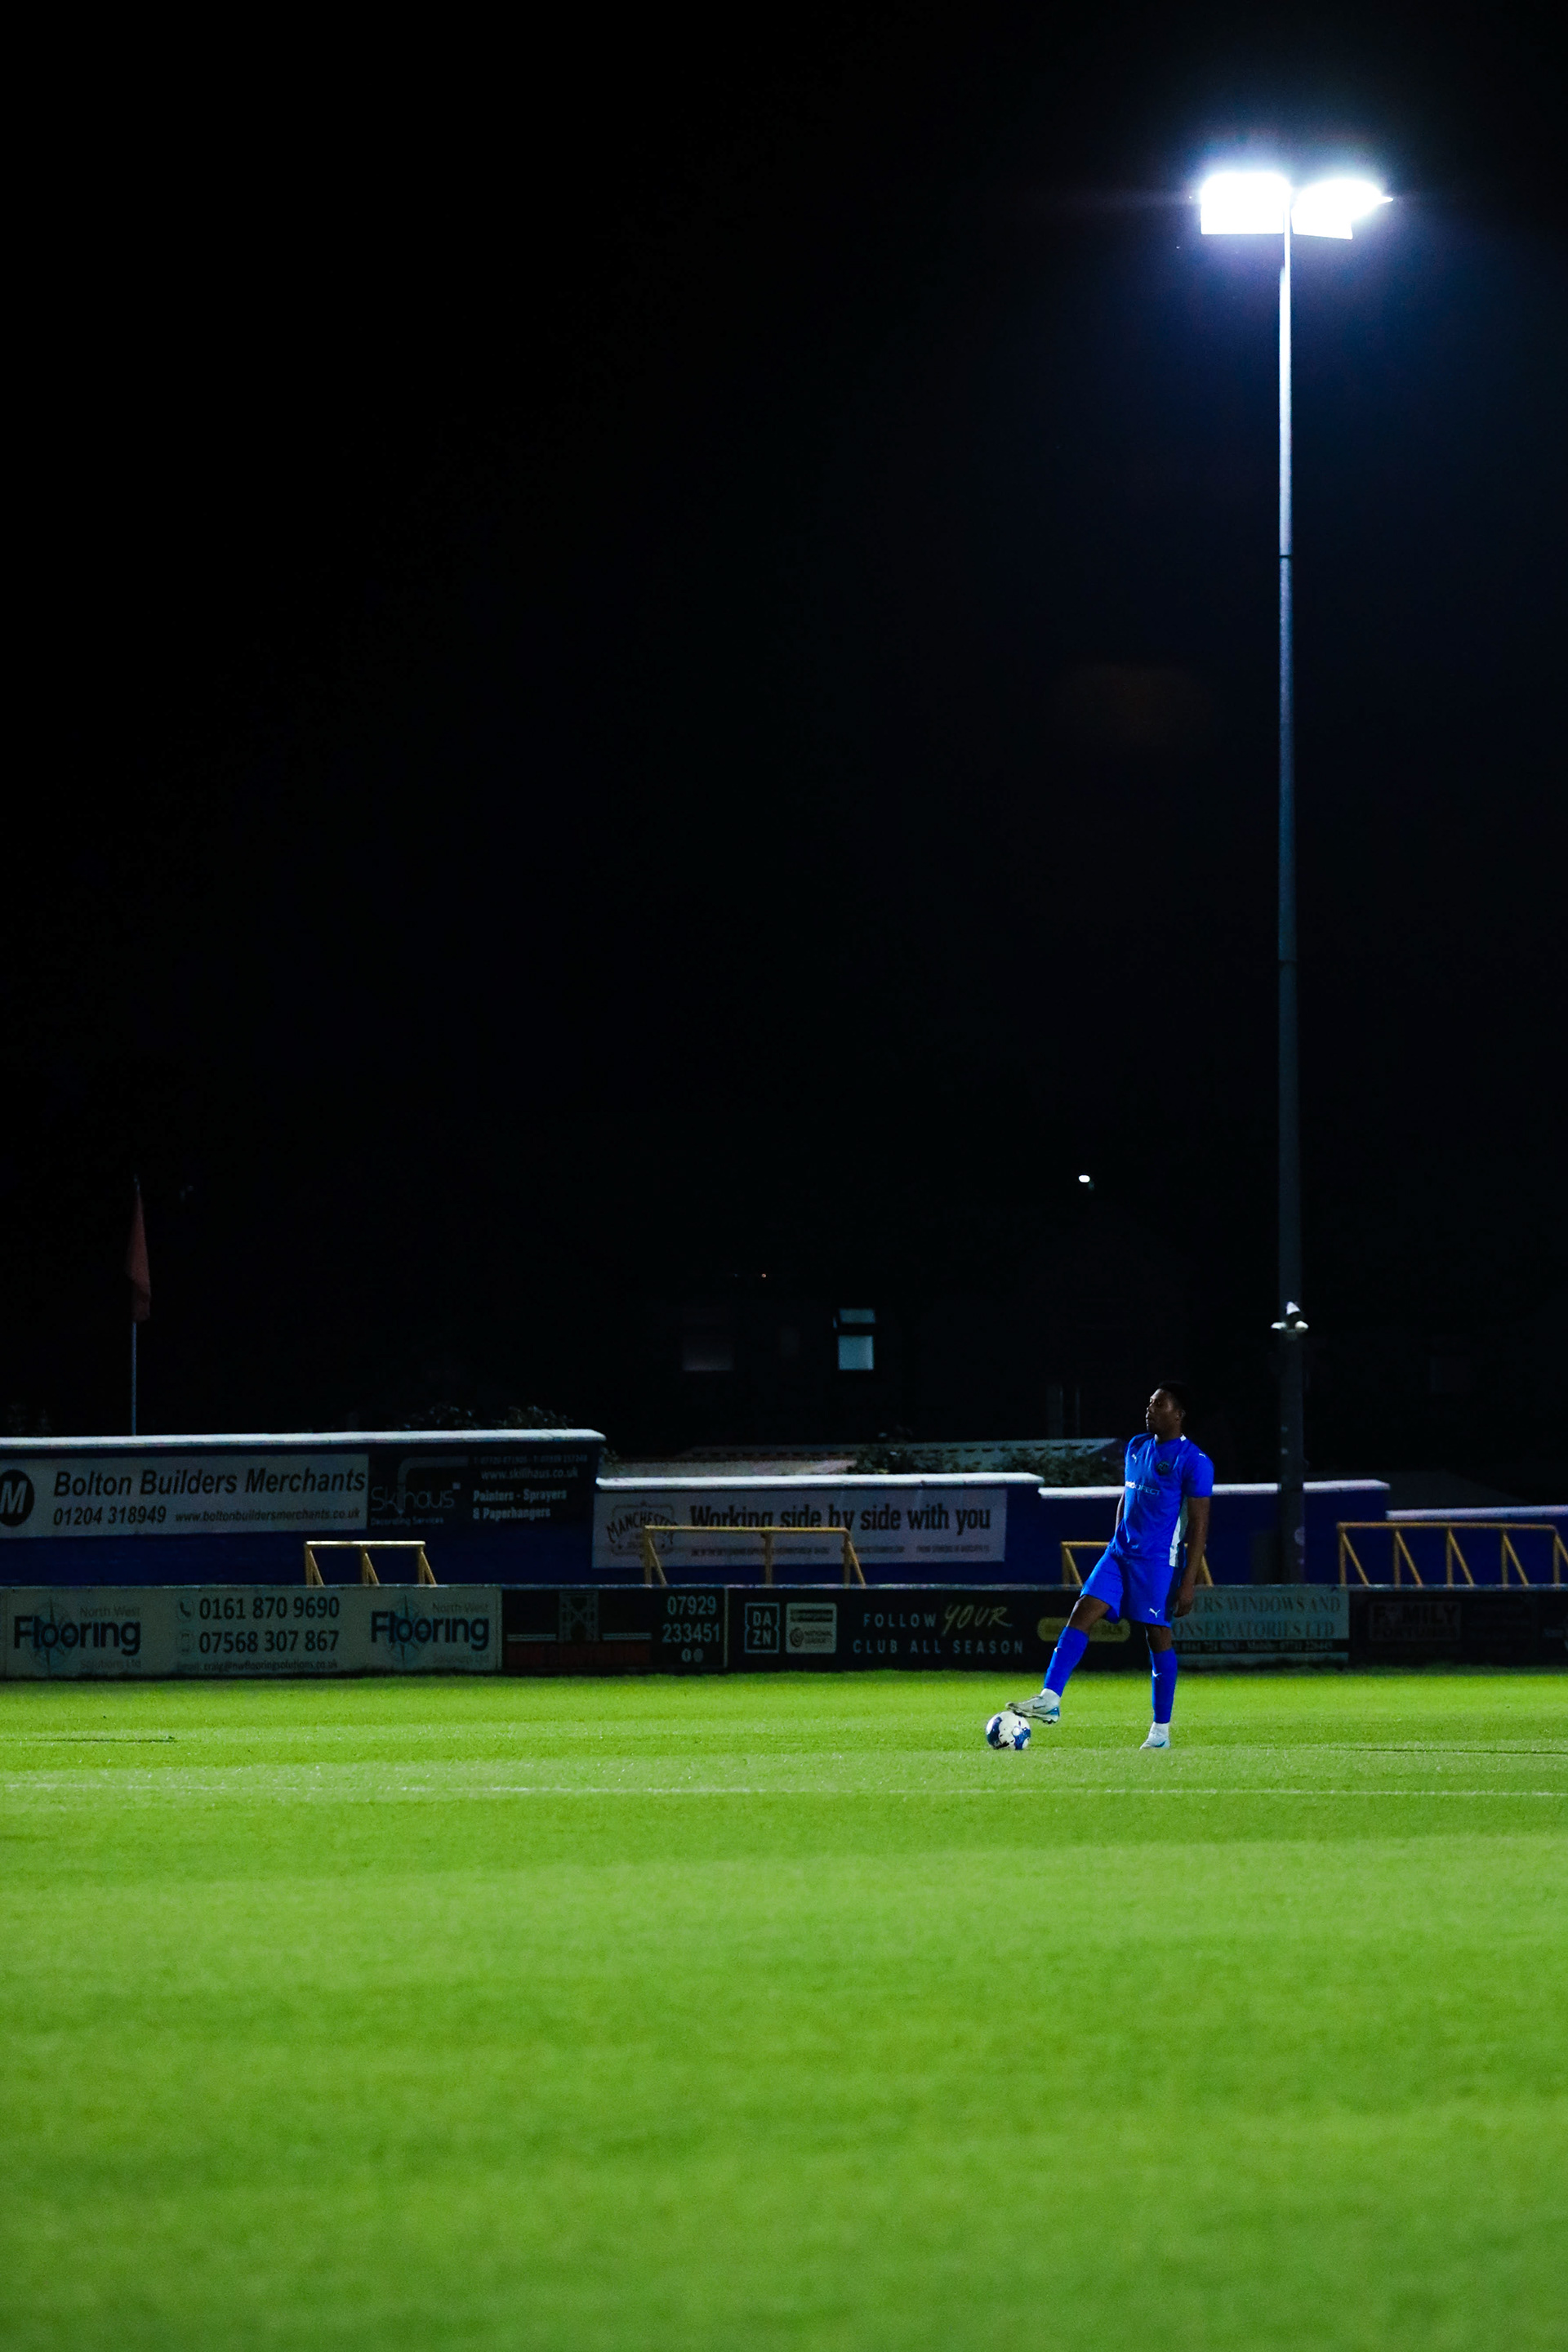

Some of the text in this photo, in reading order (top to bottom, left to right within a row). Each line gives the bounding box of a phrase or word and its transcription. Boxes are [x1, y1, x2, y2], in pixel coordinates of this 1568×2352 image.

[54, 1467, 366, 1496] Bolton Builders Merchants
[473, 1490, 514, 1502] Painters
[523, 1488, 568, 1503] Sprayers
[53, 1505, 167, 1526] 01204 318949
[473, 1507, 551, 1521] & Paperhangers
[781, 1504, 822, 1527] side
[829, 1504, 855, 1530] by
[860, 1503, 902, 1530] side
[907, 1503, 949, 1530] with
[956, 1508, 991, 1535] you
[199, 1597, 340, 1619] 0161 870 9690
[667, 1595, 717, 1615] 07929
[1227, 1597, 1305, 1613] WINDOWS
[1310, 1596, 1341, 1612] AND
[752, 1610, 773, 1627] DA
[863, 1604, 1013, 1637] FOLLOW YOUR
[14, 1615, 140, 1656] Flooring
[371, 1610, 489, 1651] Flooring
[662, 1623, 720, 1643] 233451
[752, 1629, 773, 1646] ZN
[1173, 1621, 1334, 1637] ONSERVATORIES LTD
[198, 1630, 340, 1654] 07568 307 867
[853, 1639, 1023, 1654] CLUB ALL SEASON
